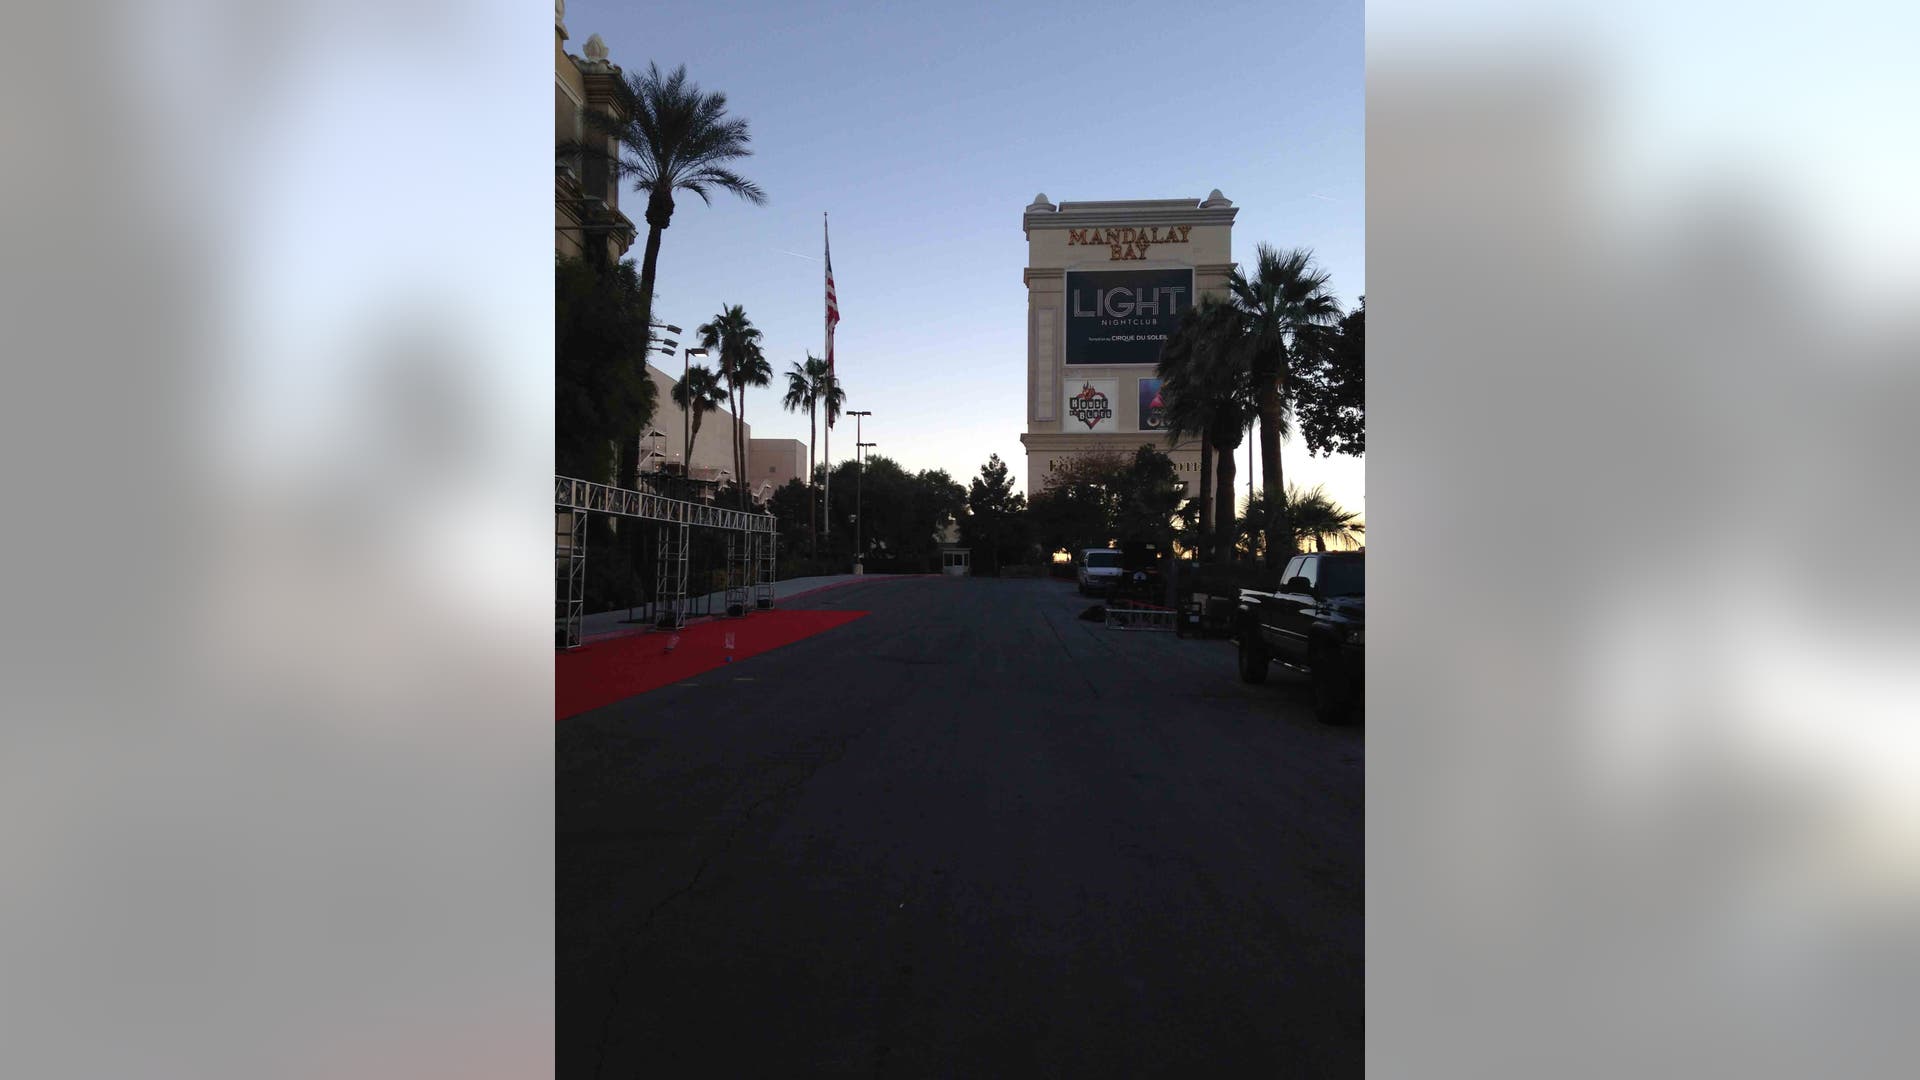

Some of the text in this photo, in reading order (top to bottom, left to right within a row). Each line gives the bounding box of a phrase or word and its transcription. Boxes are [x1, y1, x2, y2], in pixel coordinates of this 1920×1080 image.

[1068, 224, 1192, 245] MANDALAY
[1110, 243, 1150, 260] BAY
[1073, 286, 1187, 318] LIGHT
[1070, 397, 1108, 410] HOUSE
